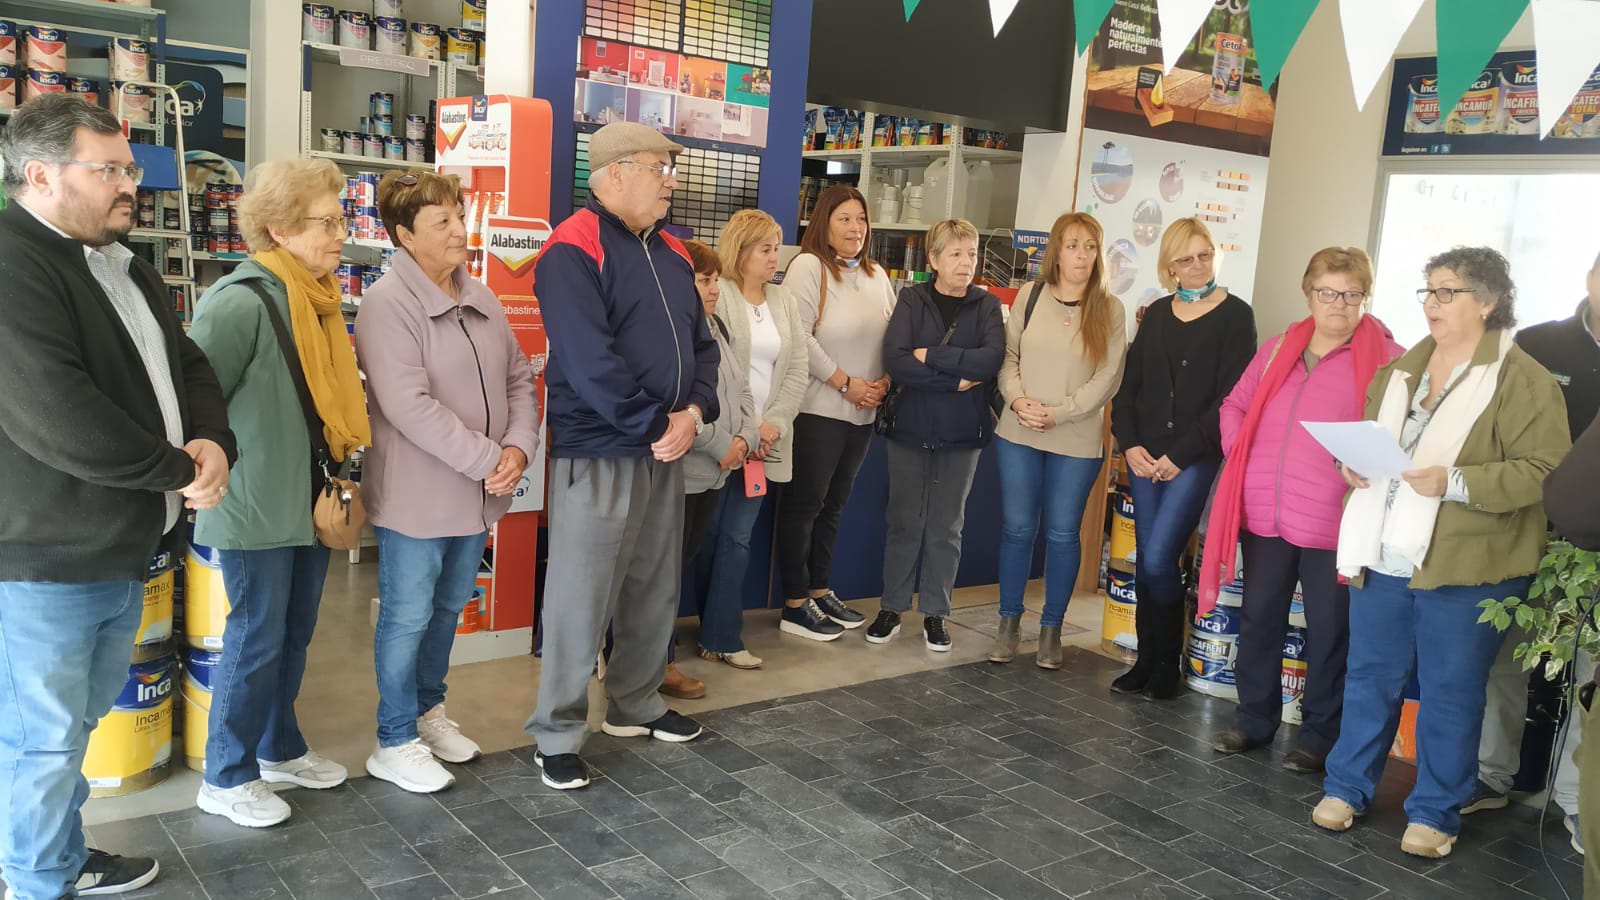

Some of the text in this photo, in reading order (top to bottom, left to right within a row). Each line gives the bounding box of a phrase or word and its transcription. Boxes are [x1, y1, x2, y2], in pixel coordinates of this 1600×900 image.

[1110, 17, 1145, 33] Maderas
[38, 33, 55, 41] Inca
[1109, 29, 1163, 48] naturalmente
[130, 45, 146, 53] Inca
[1108, 39, 1147, 54] perfectas
[1221, 39, 1242, 51] Cetol
[40, 77, 57, 85] Inca
[1412, 102, 1440, 113] INCATE
[171, 119, 192, 127] clor
[442, 111, 466, 123] Alabastine
[503, 304, 540, 315] abastine
[1122, 499, 1135, 514] In
[144, 582, 170, 595] amax
[1110, 581, 1136, 601] Inca
[137, 678, 171, 702] Inca
